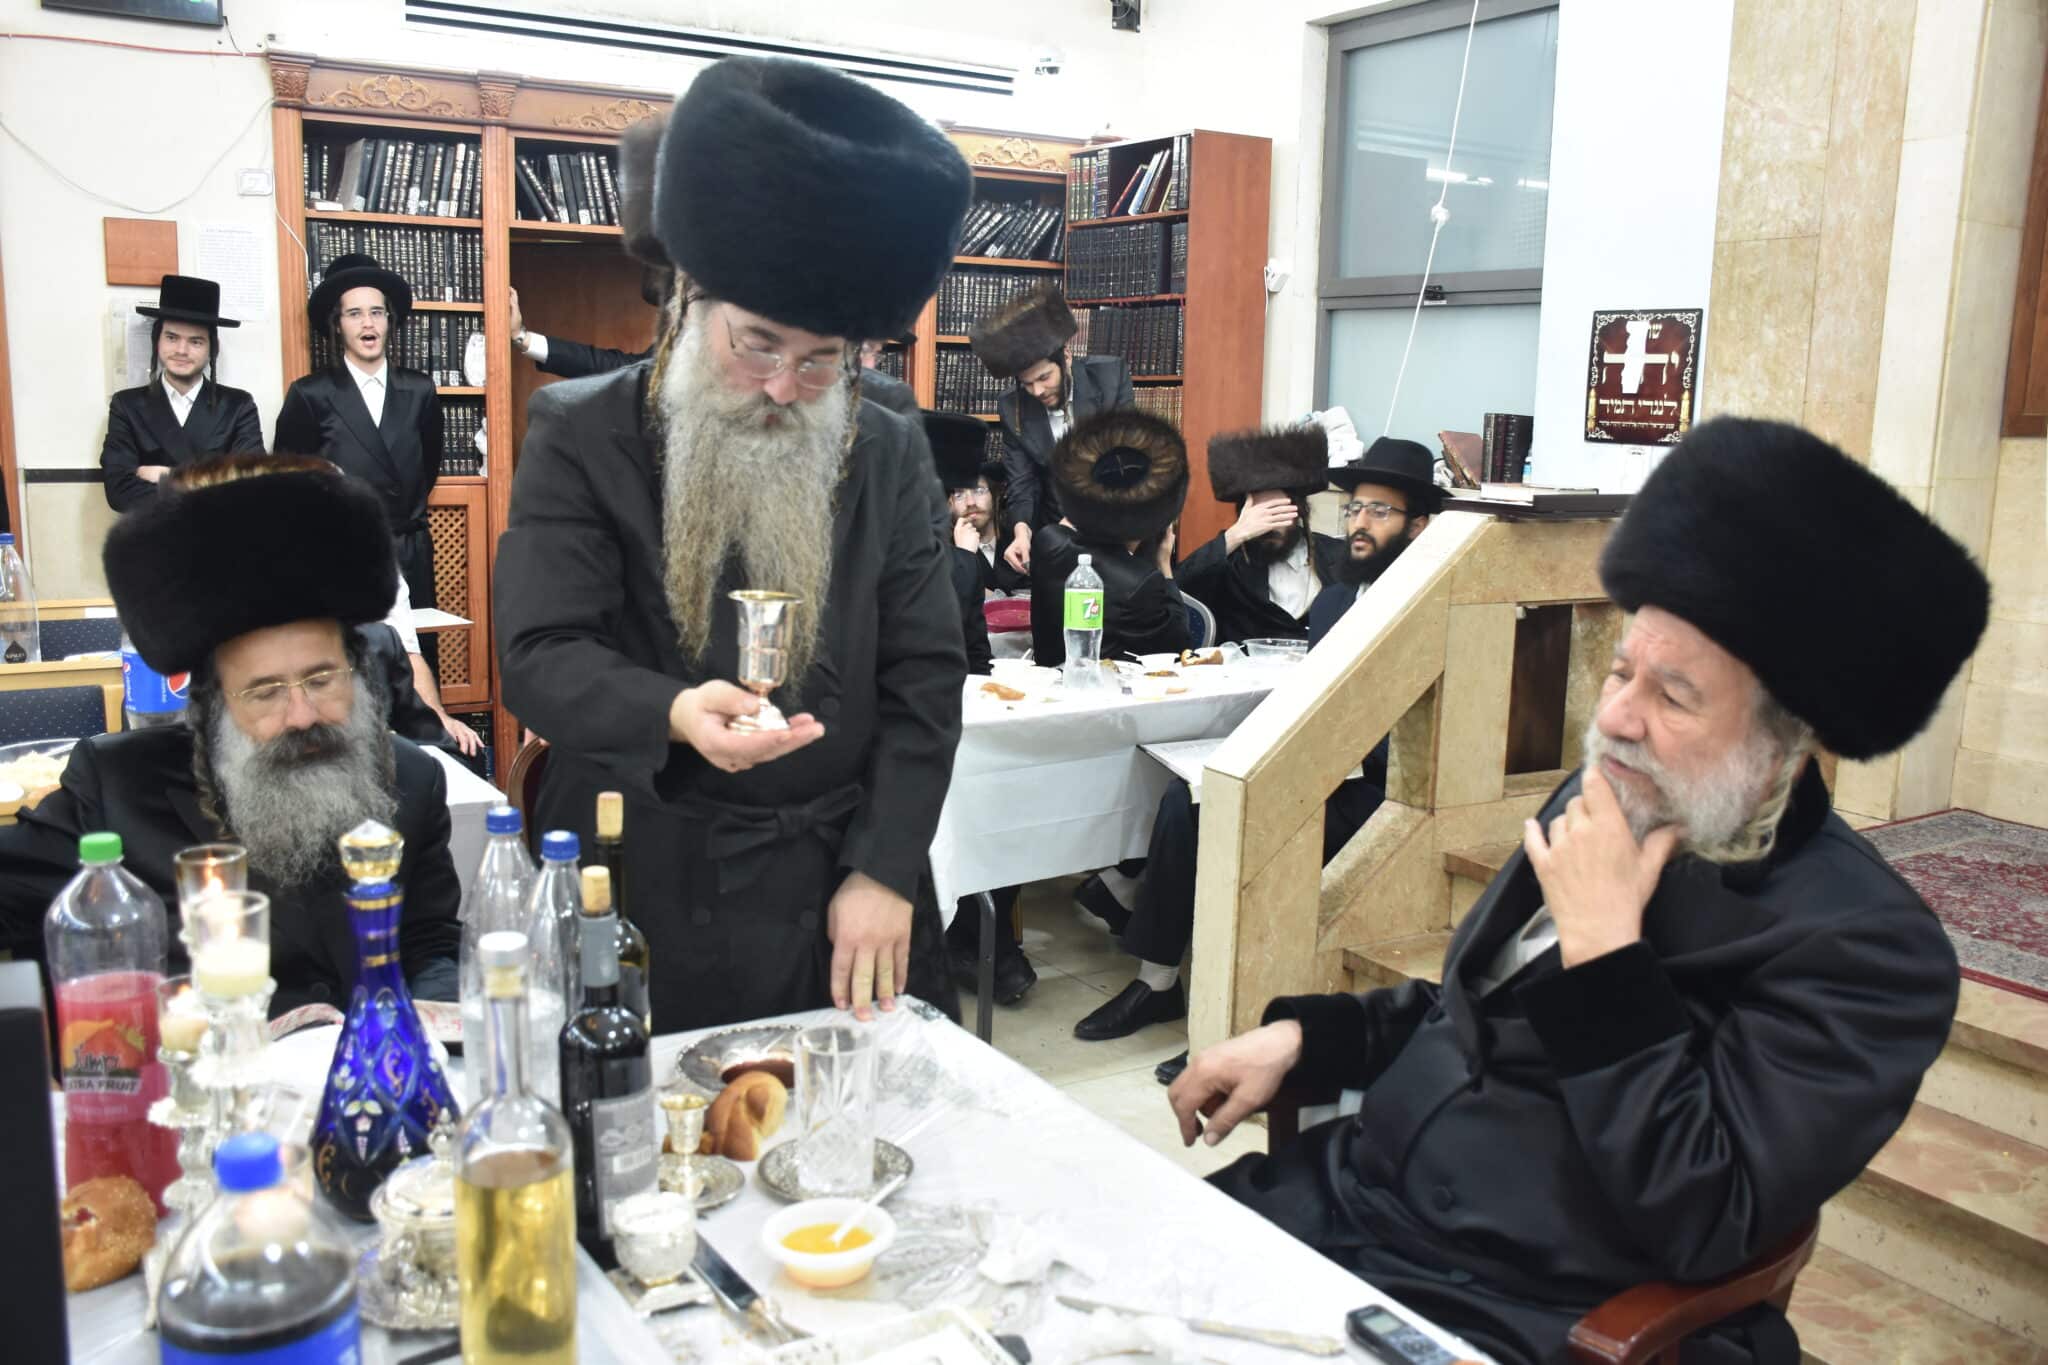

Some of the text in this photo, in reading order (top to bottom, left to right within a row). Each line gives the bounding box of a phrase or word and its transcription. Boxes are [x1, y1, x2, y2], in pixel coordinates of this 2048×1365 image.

[1602, 350, 1680, 385] יהה
[1599, 393, 1678, 416] לנגדי תמיד
[97, 1079, 137, 1092] FRUIT
